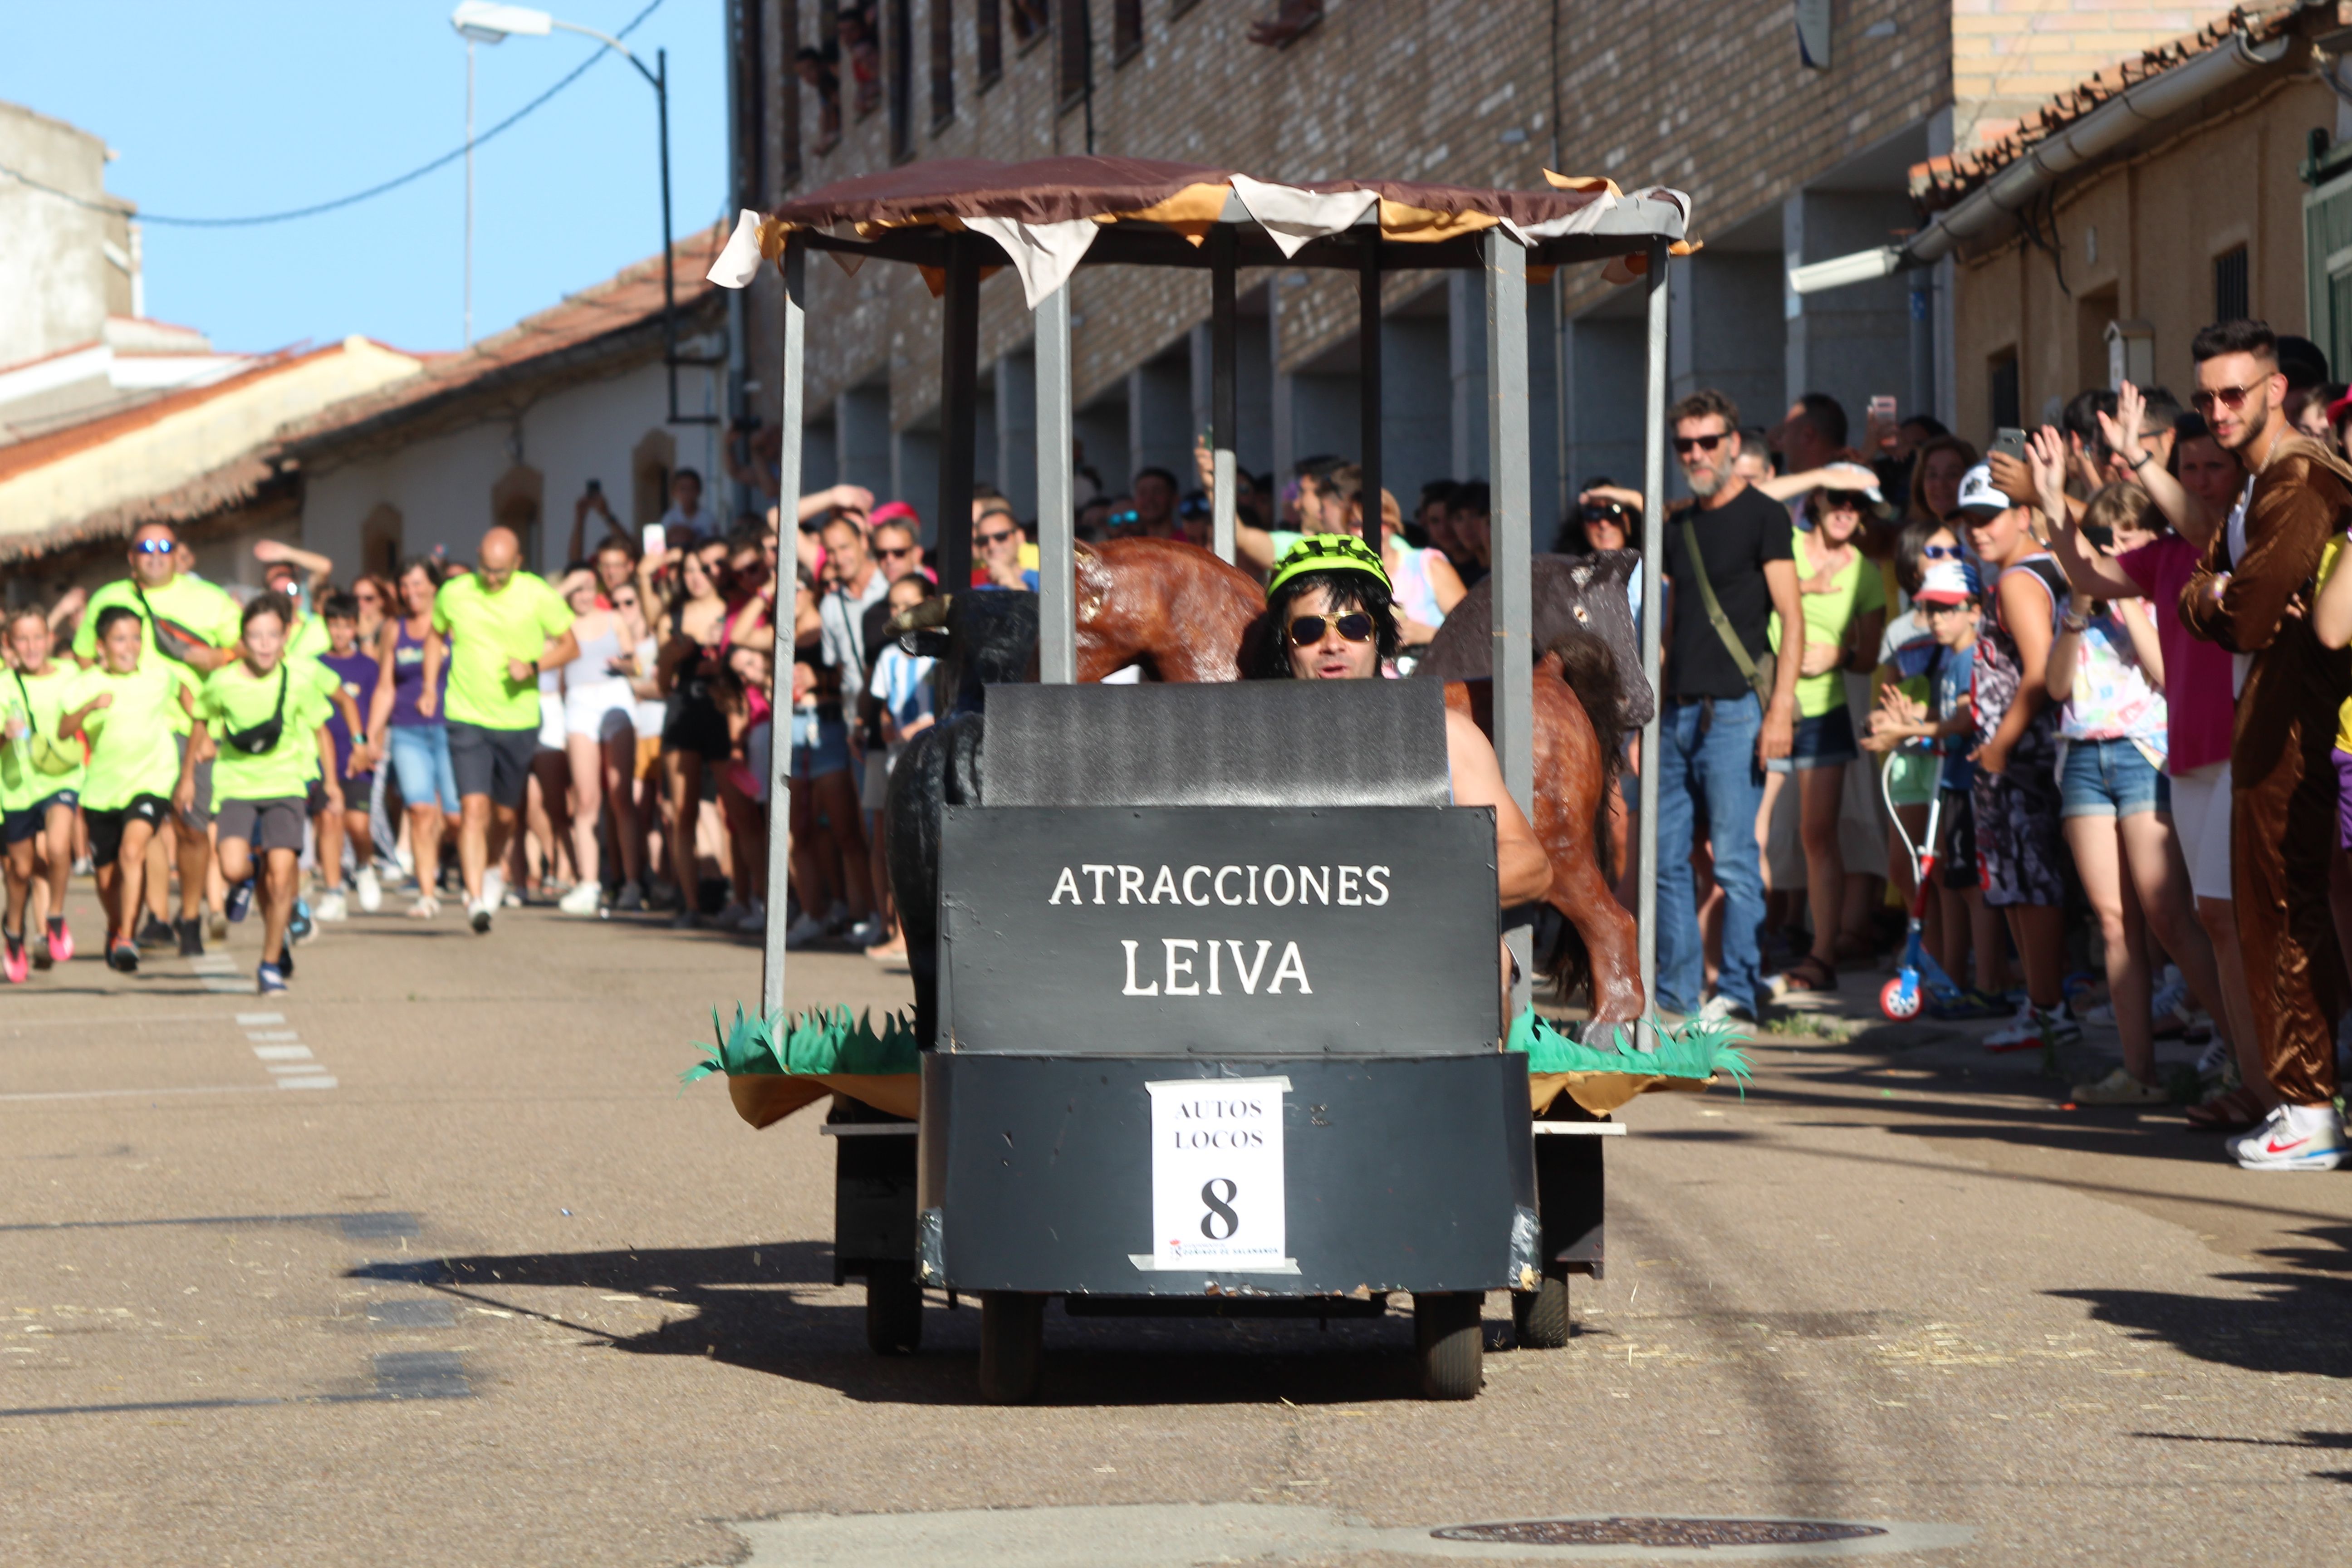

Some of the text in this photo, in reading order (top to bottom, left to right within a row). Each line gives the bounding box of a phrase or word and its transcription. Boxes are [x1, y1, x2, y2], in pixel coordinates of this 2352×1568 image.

[1048, 863, 1390, 906] ATRACCIONES
[1121, 938, 1313, 996] LEIVA
[1175, 1099, 1262, 1119] AUTOS
[1175, 1129, 1263, 1149] LOCOS
[1200, 1178, 1239, 1240] 8
